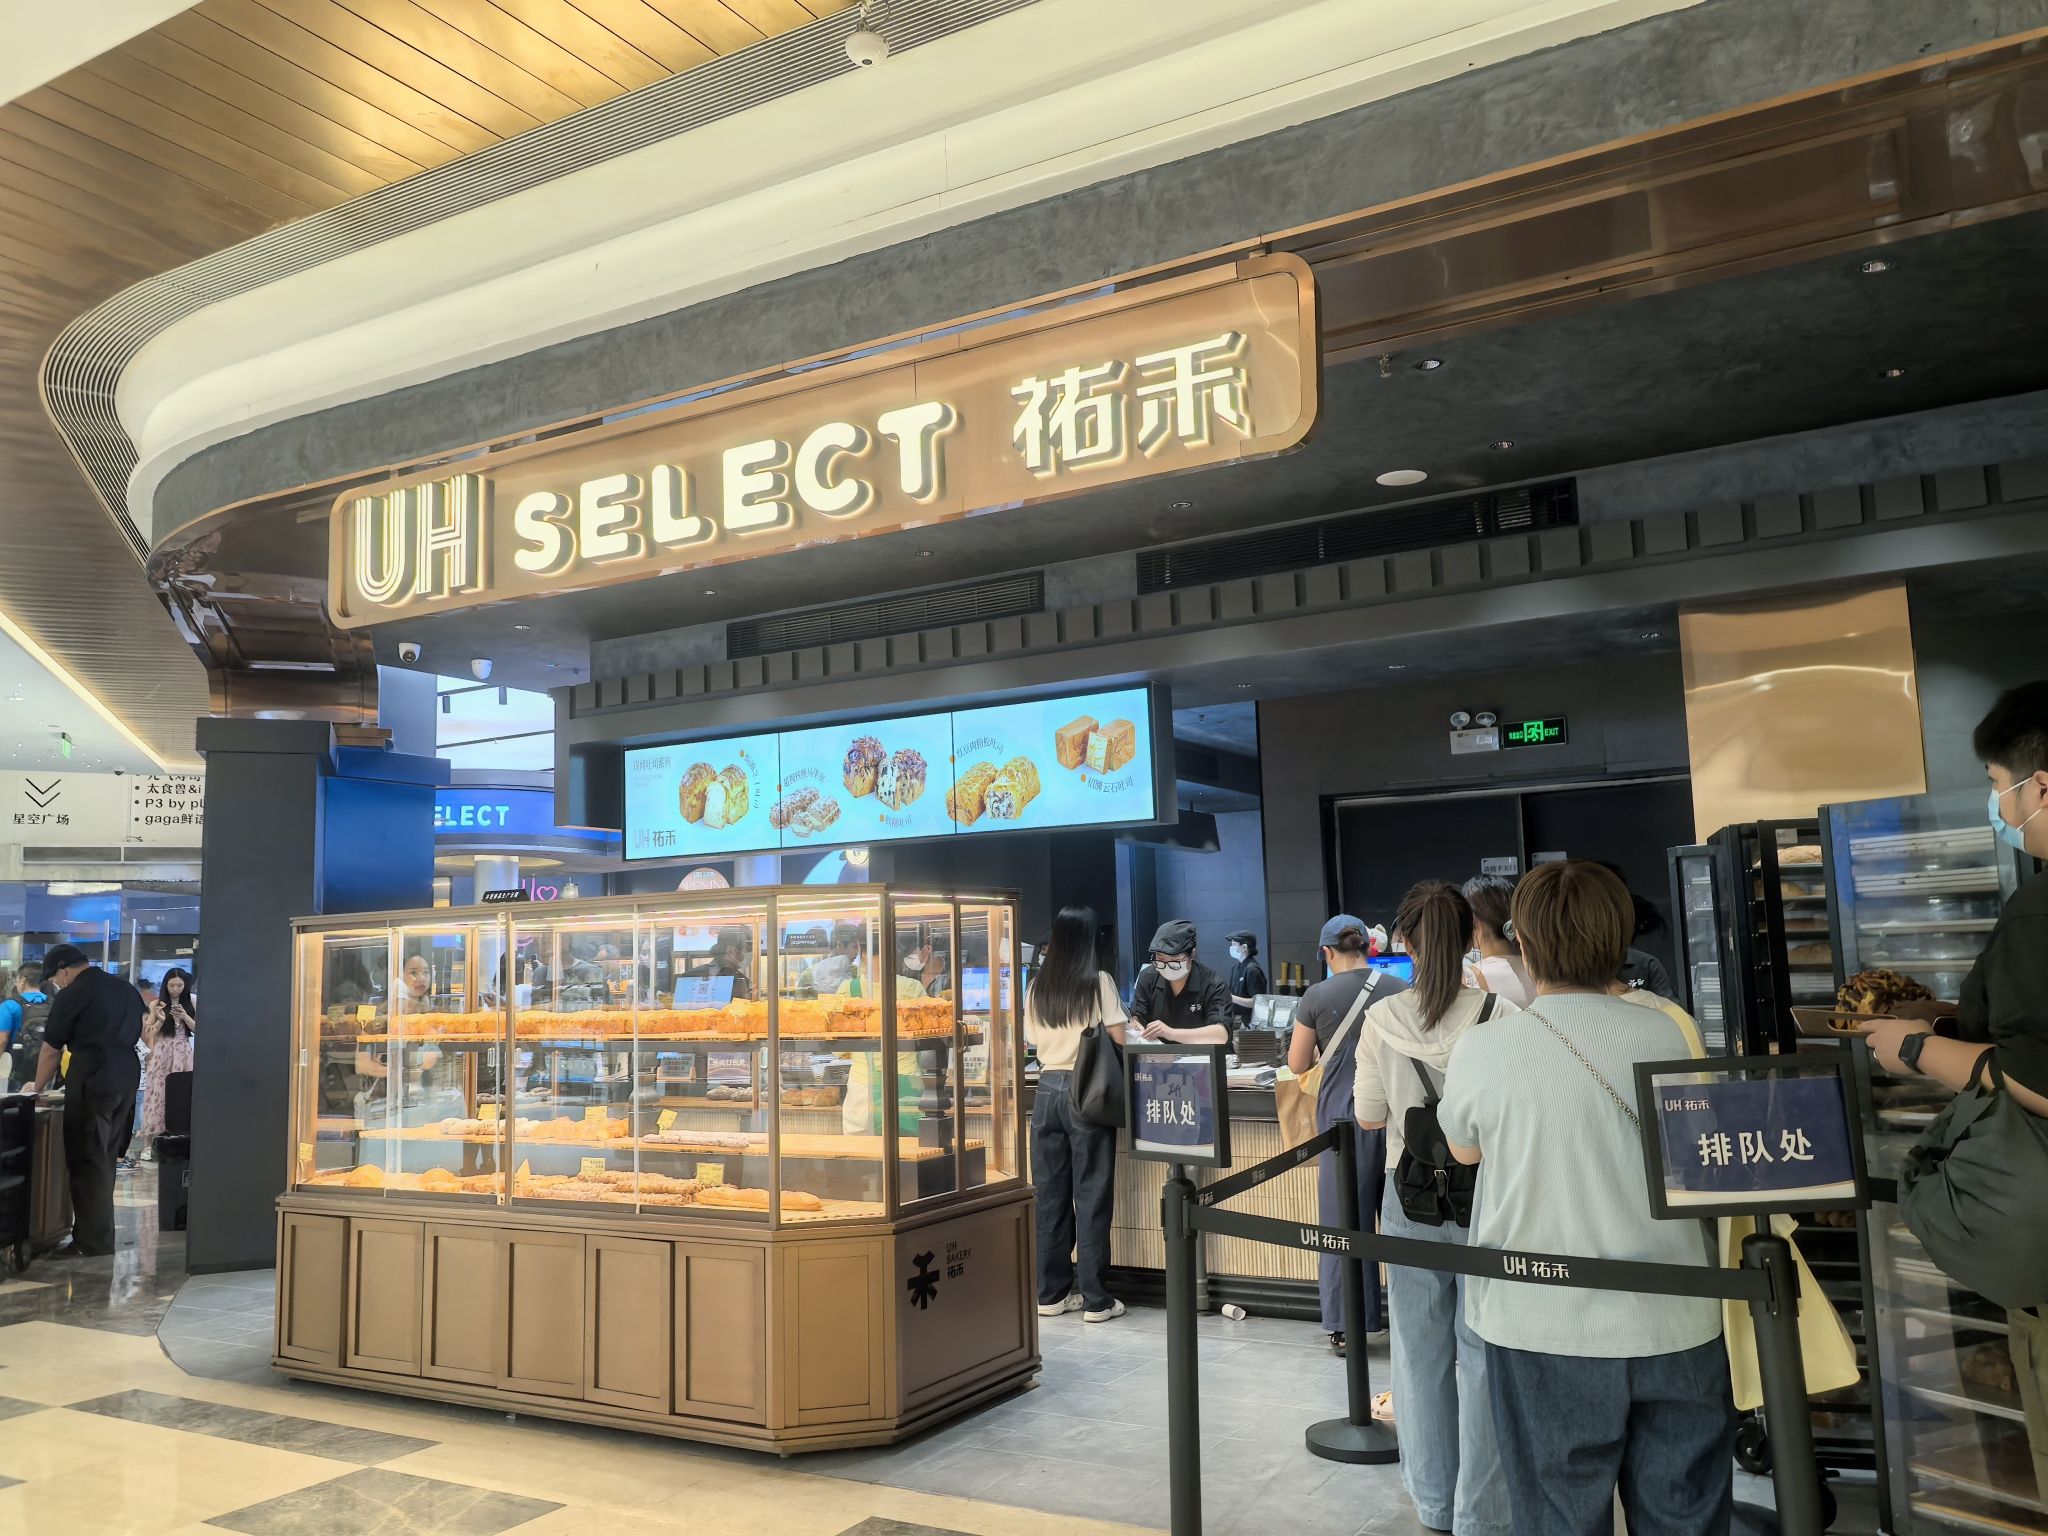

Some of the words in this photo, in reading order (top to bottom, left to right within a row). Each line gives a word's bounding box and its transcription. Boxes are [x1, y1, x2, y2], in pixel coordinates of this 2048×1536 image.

[356, 472, 488, 605] UH
[514, 402, 960, 573] SELECT
[1011, 331, 1254, 474] 祐禾
[1544, 727, 1560, 737] EXIT
[145, 798, 163, 809] P3
[169, 798, 184, 811] by
[13, 813, 70, 826] 星空广场
[1146, 1099, 1196, 1126] 排队处
[1664, 1100, 1682, 1111] UH
[1684, 1099, 1710, 1111] 祐禾
[1697, 1128, 1815, 1166] 排队处
[1300, 1229, 1319, 1247] UH
[1322, 1234, 1350, 1251] 祐禾
[1503, 1255, 1527, 1276] UH
[1531, 1261, 1570, 1279] 祐禾
